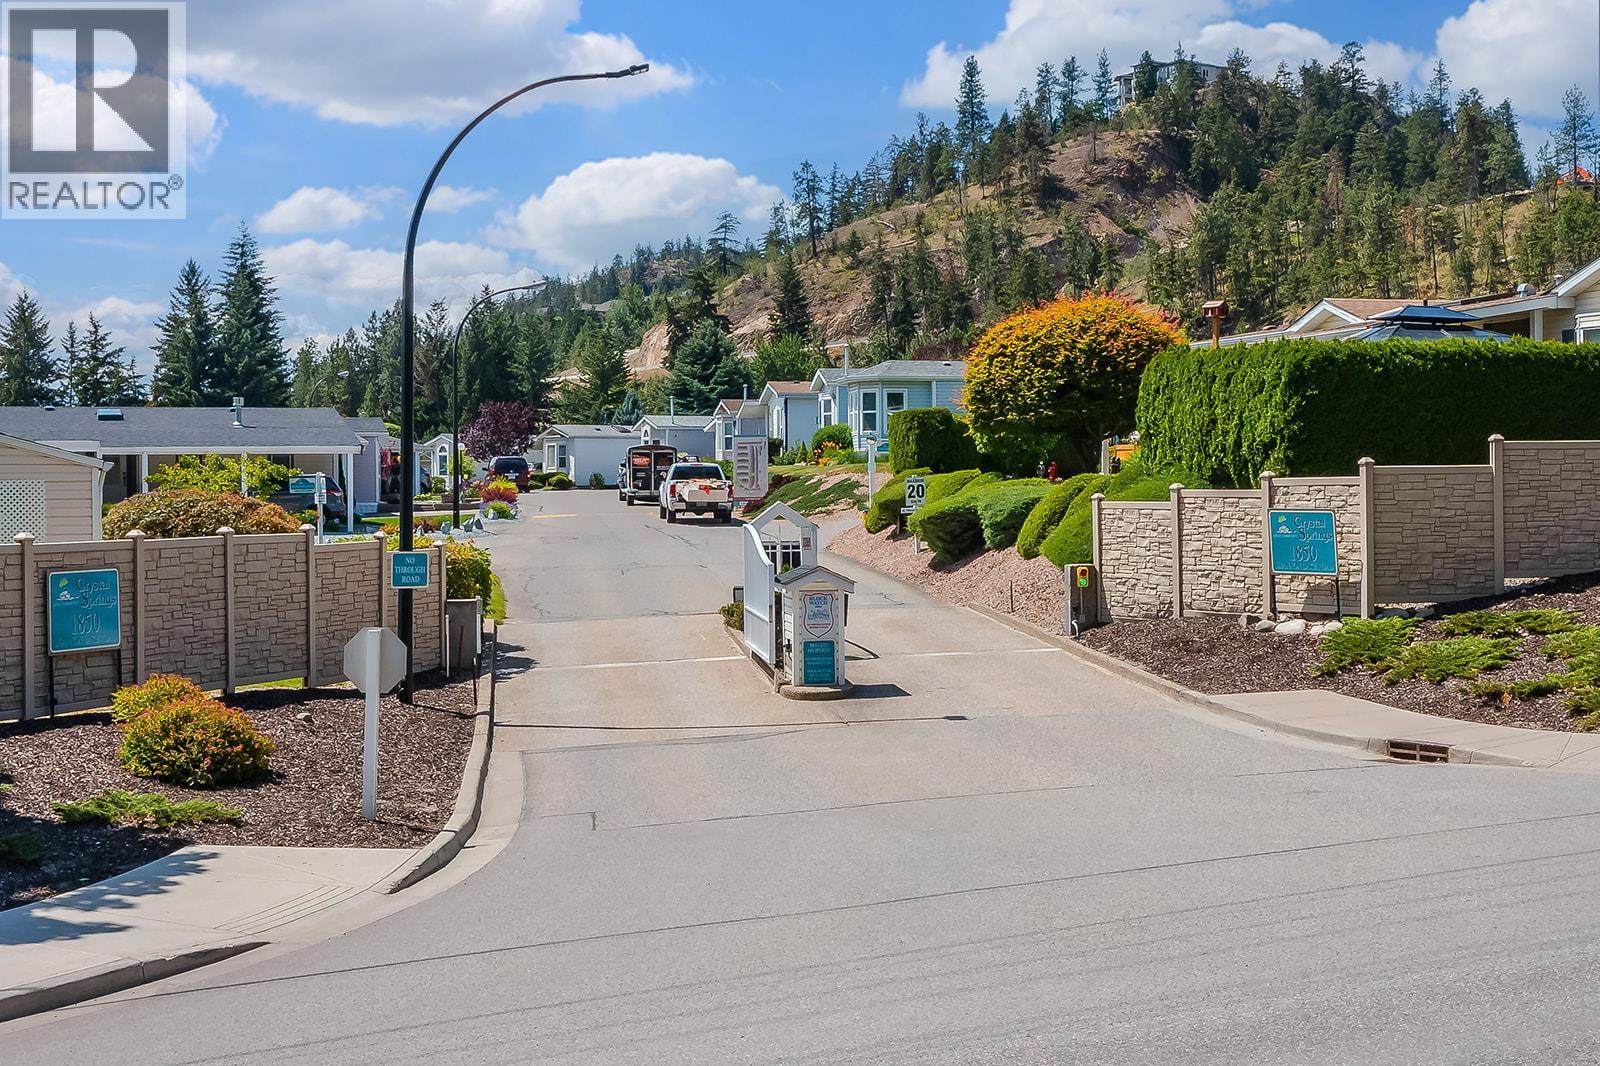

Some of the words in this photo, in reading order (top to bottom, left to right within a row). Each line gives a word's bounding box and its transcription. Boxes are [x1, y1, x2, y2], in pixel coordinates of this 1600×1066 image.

[907, 484, 925, 499] 20
[1293, 515, 1327, 530] Crystal
[1298, 527, 1334, 544] Springs
[405, 556, 416, 564] NO
[1290, 544, 1318, 562] 1850
[394, 566, 426, 574] THROUGH
[76, 576, 109, 593] Crystal
[401, 575, 420, 583] ROAD
[81, 591, 117, 609] Springs
[72, 611, 101, 636] 1850
